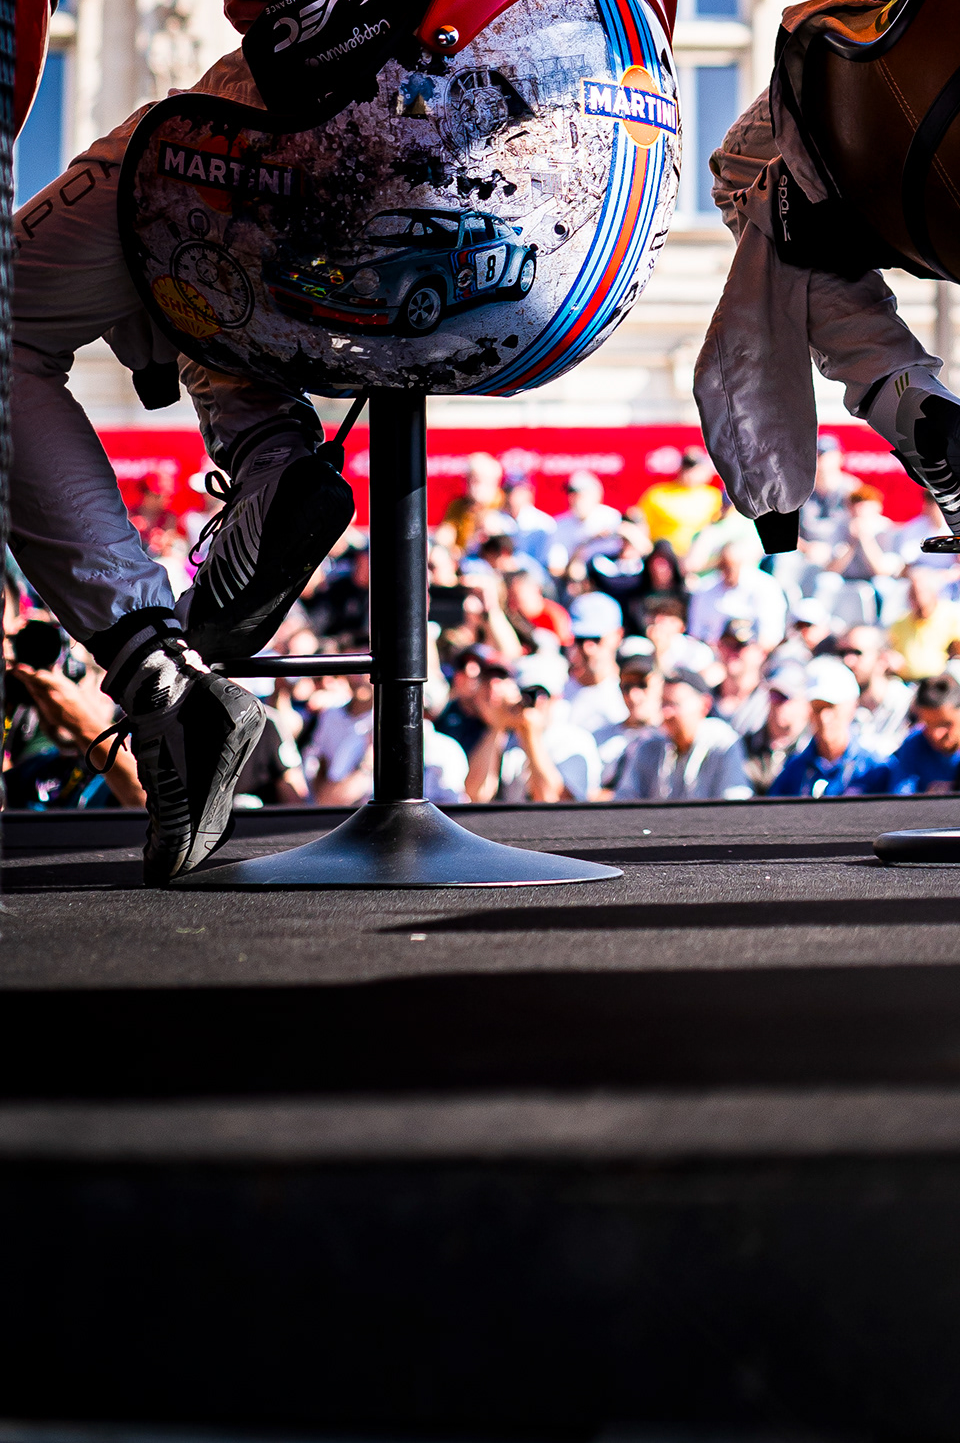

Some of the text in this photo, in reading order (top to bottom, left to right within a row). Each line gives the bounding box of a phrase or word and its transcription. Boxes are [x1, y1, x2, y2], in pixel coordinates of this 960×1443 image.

[317, 18, 391, 64] Capgemini
[588, 84, 676, 130] MARTINI
[485, 254, 497, 282] 8
